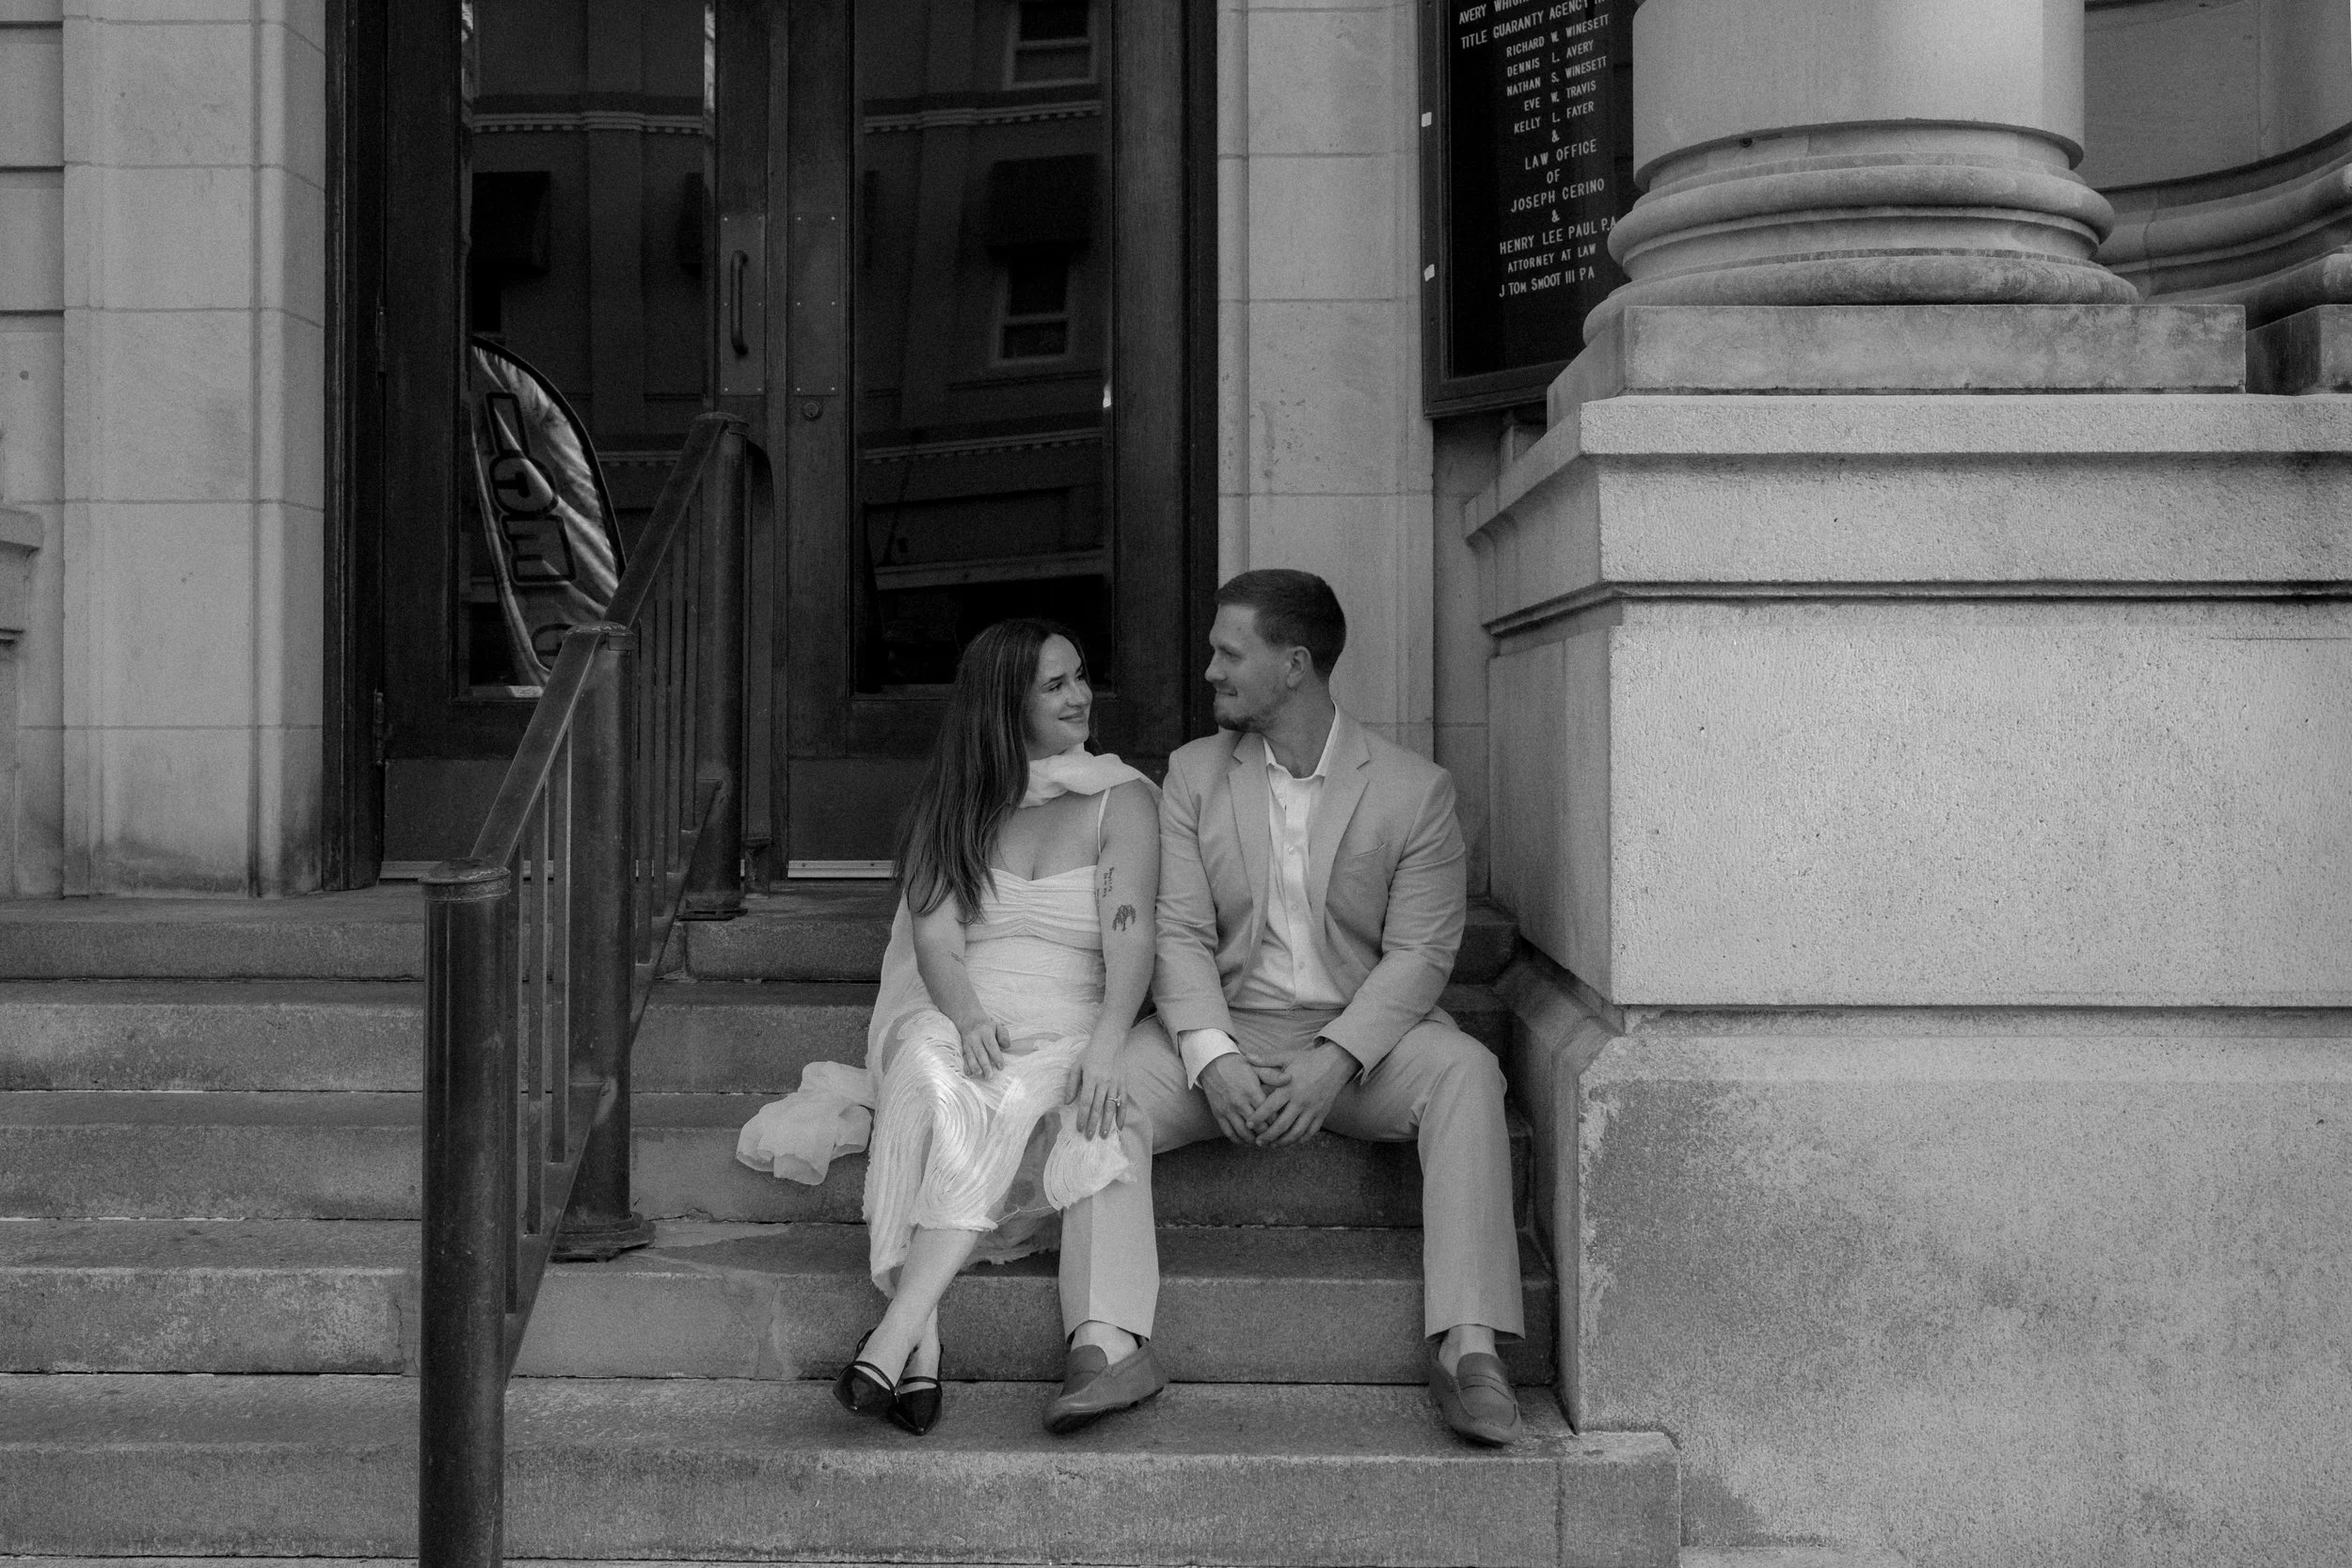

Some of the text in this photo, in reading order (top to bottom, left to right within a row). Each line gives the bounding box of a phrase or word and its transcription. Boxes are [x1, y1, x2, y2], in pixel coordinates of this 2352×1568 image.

[1459, 0, 1529, 24] AVERY WRI
[1461, 29, 1487, 49] TITLE
[1493, 10, 1545, 39] GUARANTY
[1506, 36, 1545, 57] RICHARD
[1565, 14, 1609, 38] WINESETT
[1507, 40, 1595, 77] DENNIS L. AVERY
[1506, 55, 1607, 97] NATHAN S. WINESETT
[1524, 97, 1541, 112] EVE
[1565, 80, 1597, 99] TRAVIS
[1514, 101, 1595, 134] KELLY L. FAYER
[1551, 130, 1560, 143] &
[1524, 138, 1597, 170] LAW OFFICE
[1546, 168, 1561, 184] OF
[1511, 178, 1605, 213] JOSEPH CERINO
[1551, 209, 1560, 223] &
[1500, 235, 1534, 255] HENRY
[1542, 229, 1563, 245] LEE
[1568, 221, 1597, 240] PAUL
[1507, 244, 1597, 273] ATTORNEY AT LAW
[1508, 280, 1527, 295] TOM
[1531, 273, 1561, 291] SMOOT
[1565, 269, 1575, 284] III
